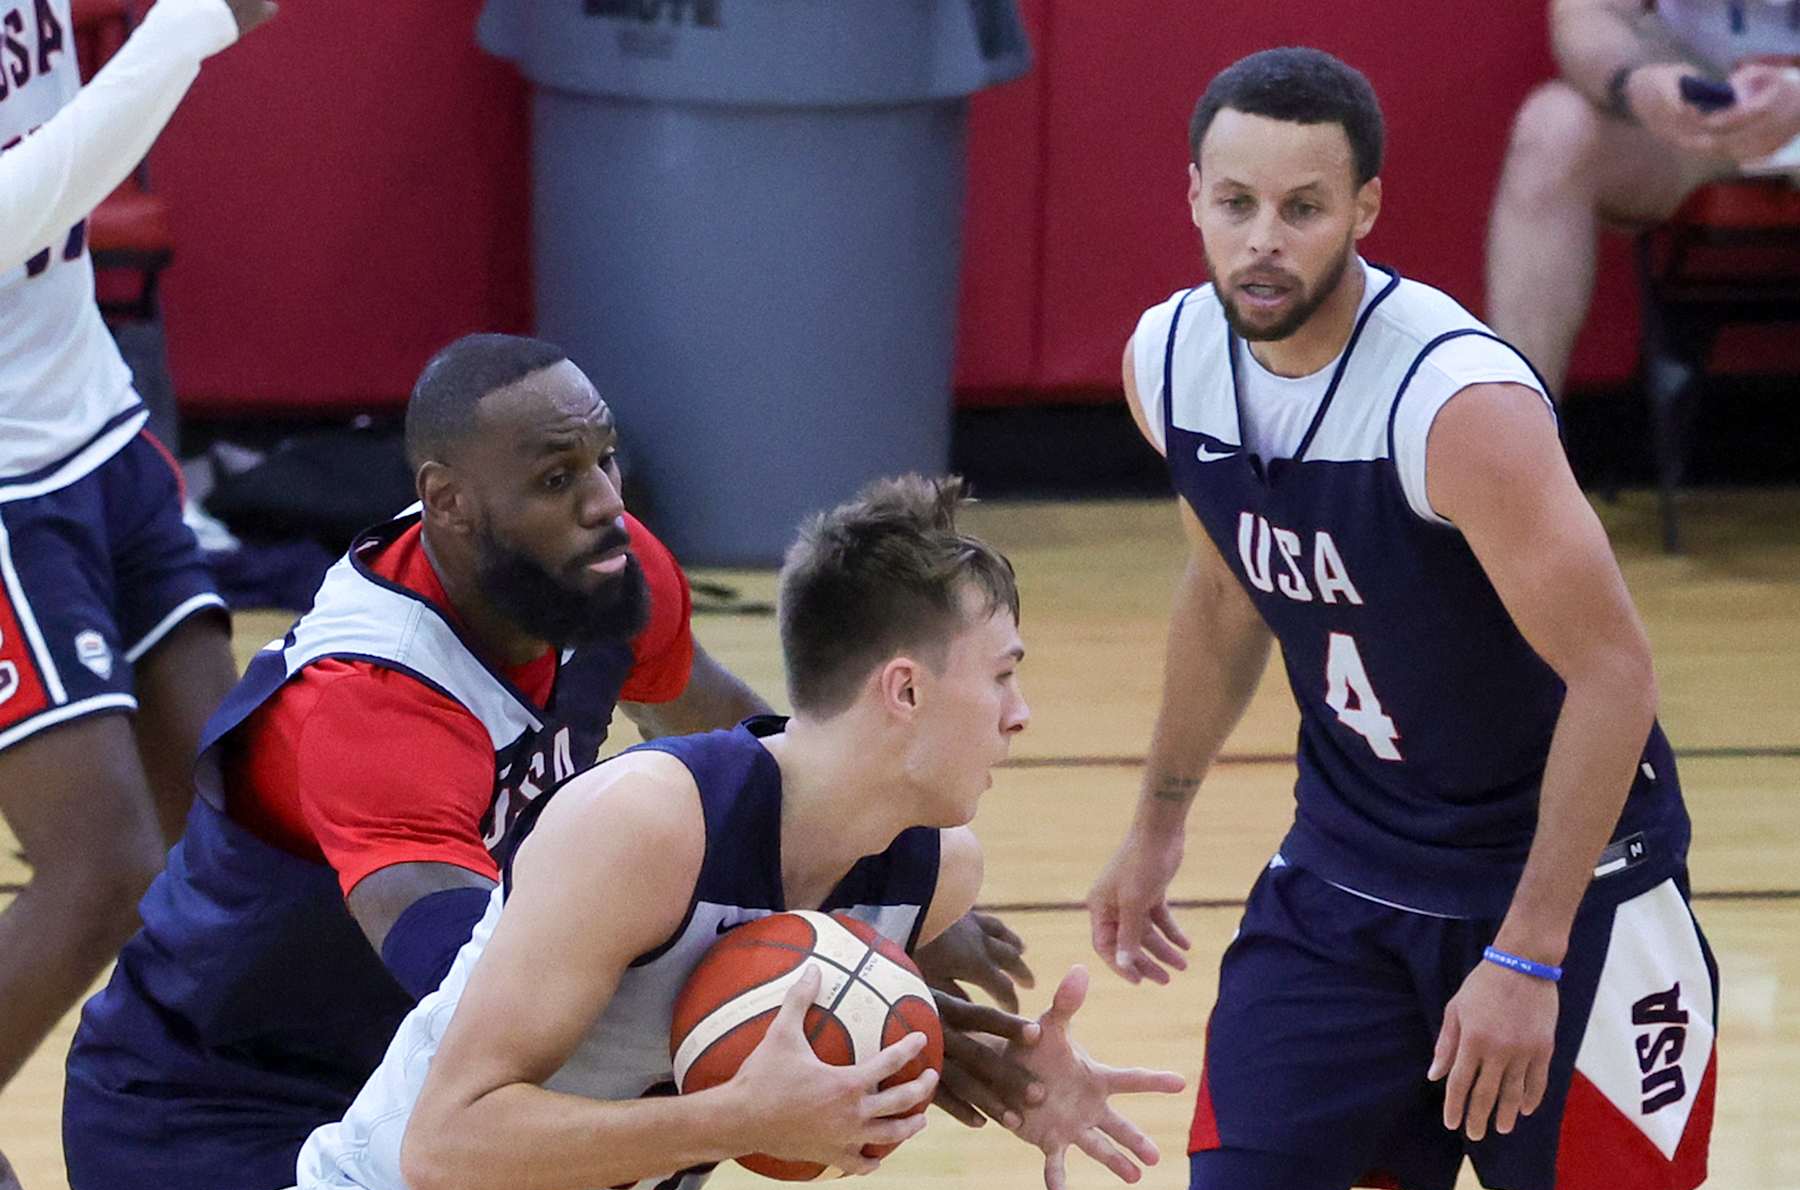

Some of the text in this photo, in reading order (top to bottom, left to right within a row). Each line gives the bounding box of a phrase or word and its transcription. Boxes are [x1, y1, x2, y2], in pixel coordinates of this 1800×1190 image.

[0, 0, 64, 100] SA
[1237, 511, 1364, 605] USA
[1324, 632, 1403, 760] 4
[1631, 981, 1690, 1116] USA
